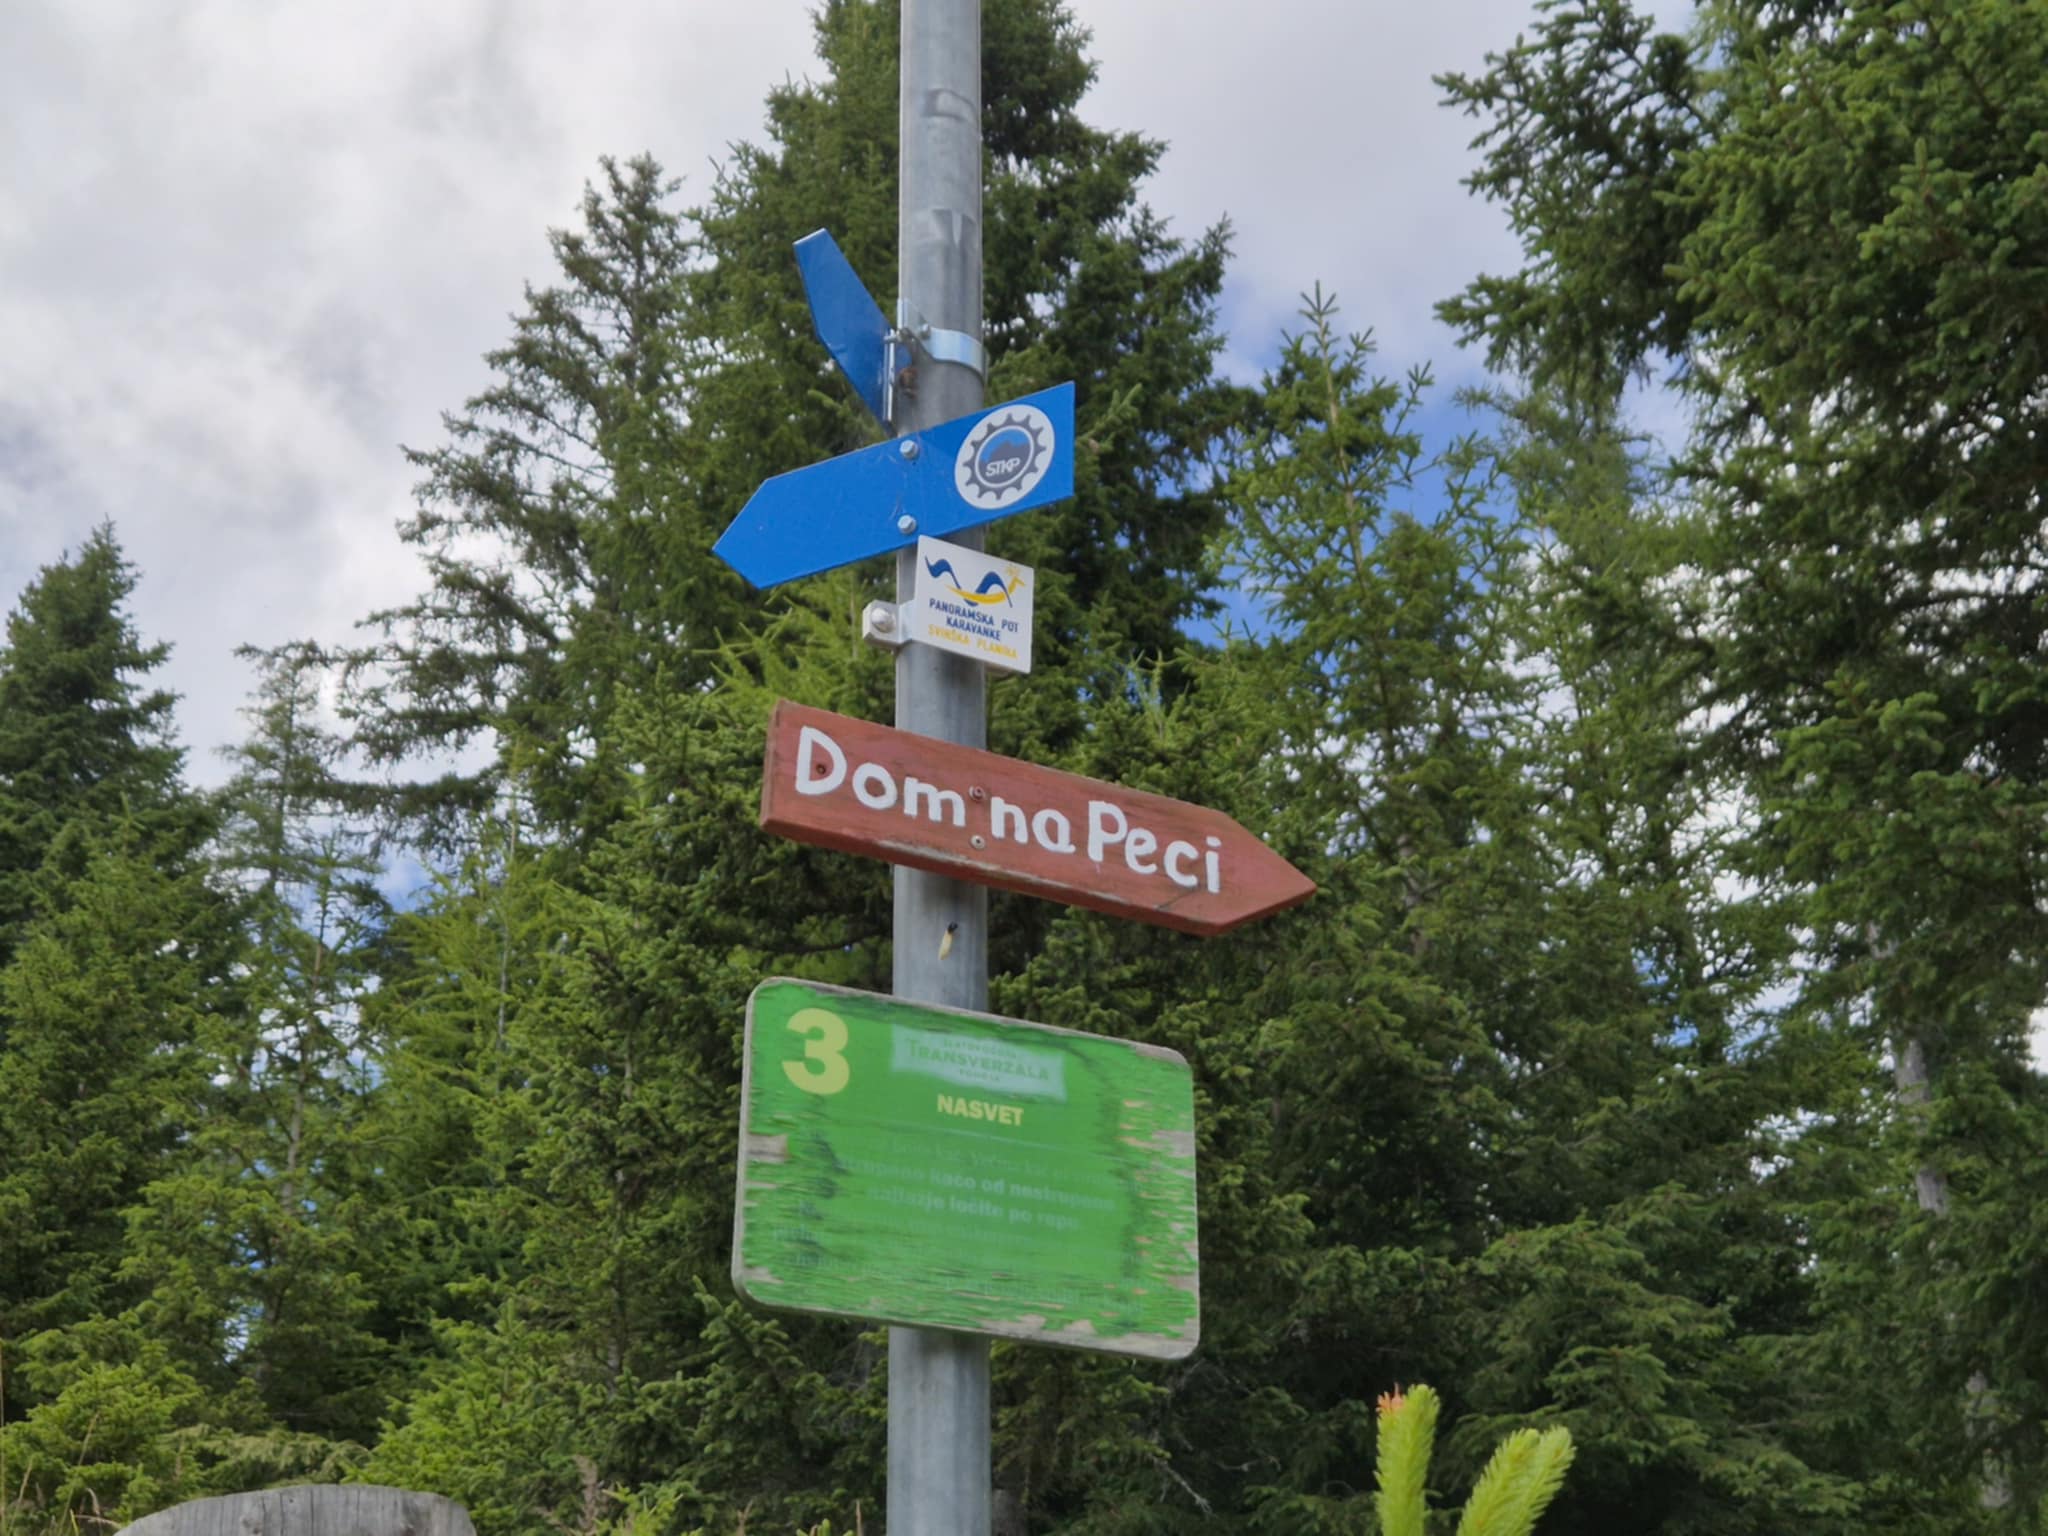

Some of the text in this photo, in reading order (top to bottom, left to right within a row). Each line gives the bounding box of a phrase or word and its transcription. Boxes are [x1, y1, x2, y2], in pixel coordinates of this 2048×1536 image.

[929, 598, 1019, 633] PANORAMSKA POT
[946, 616, 1001, 641] KARAVANKE
[795, 725, 1222, 893] Dom na Peci
[781, 1007, 850, 1095] 3
[906, 1039, 1049, 1080] TRANSVERZALA
[937, 1093, 1024, 1127] NASVET
